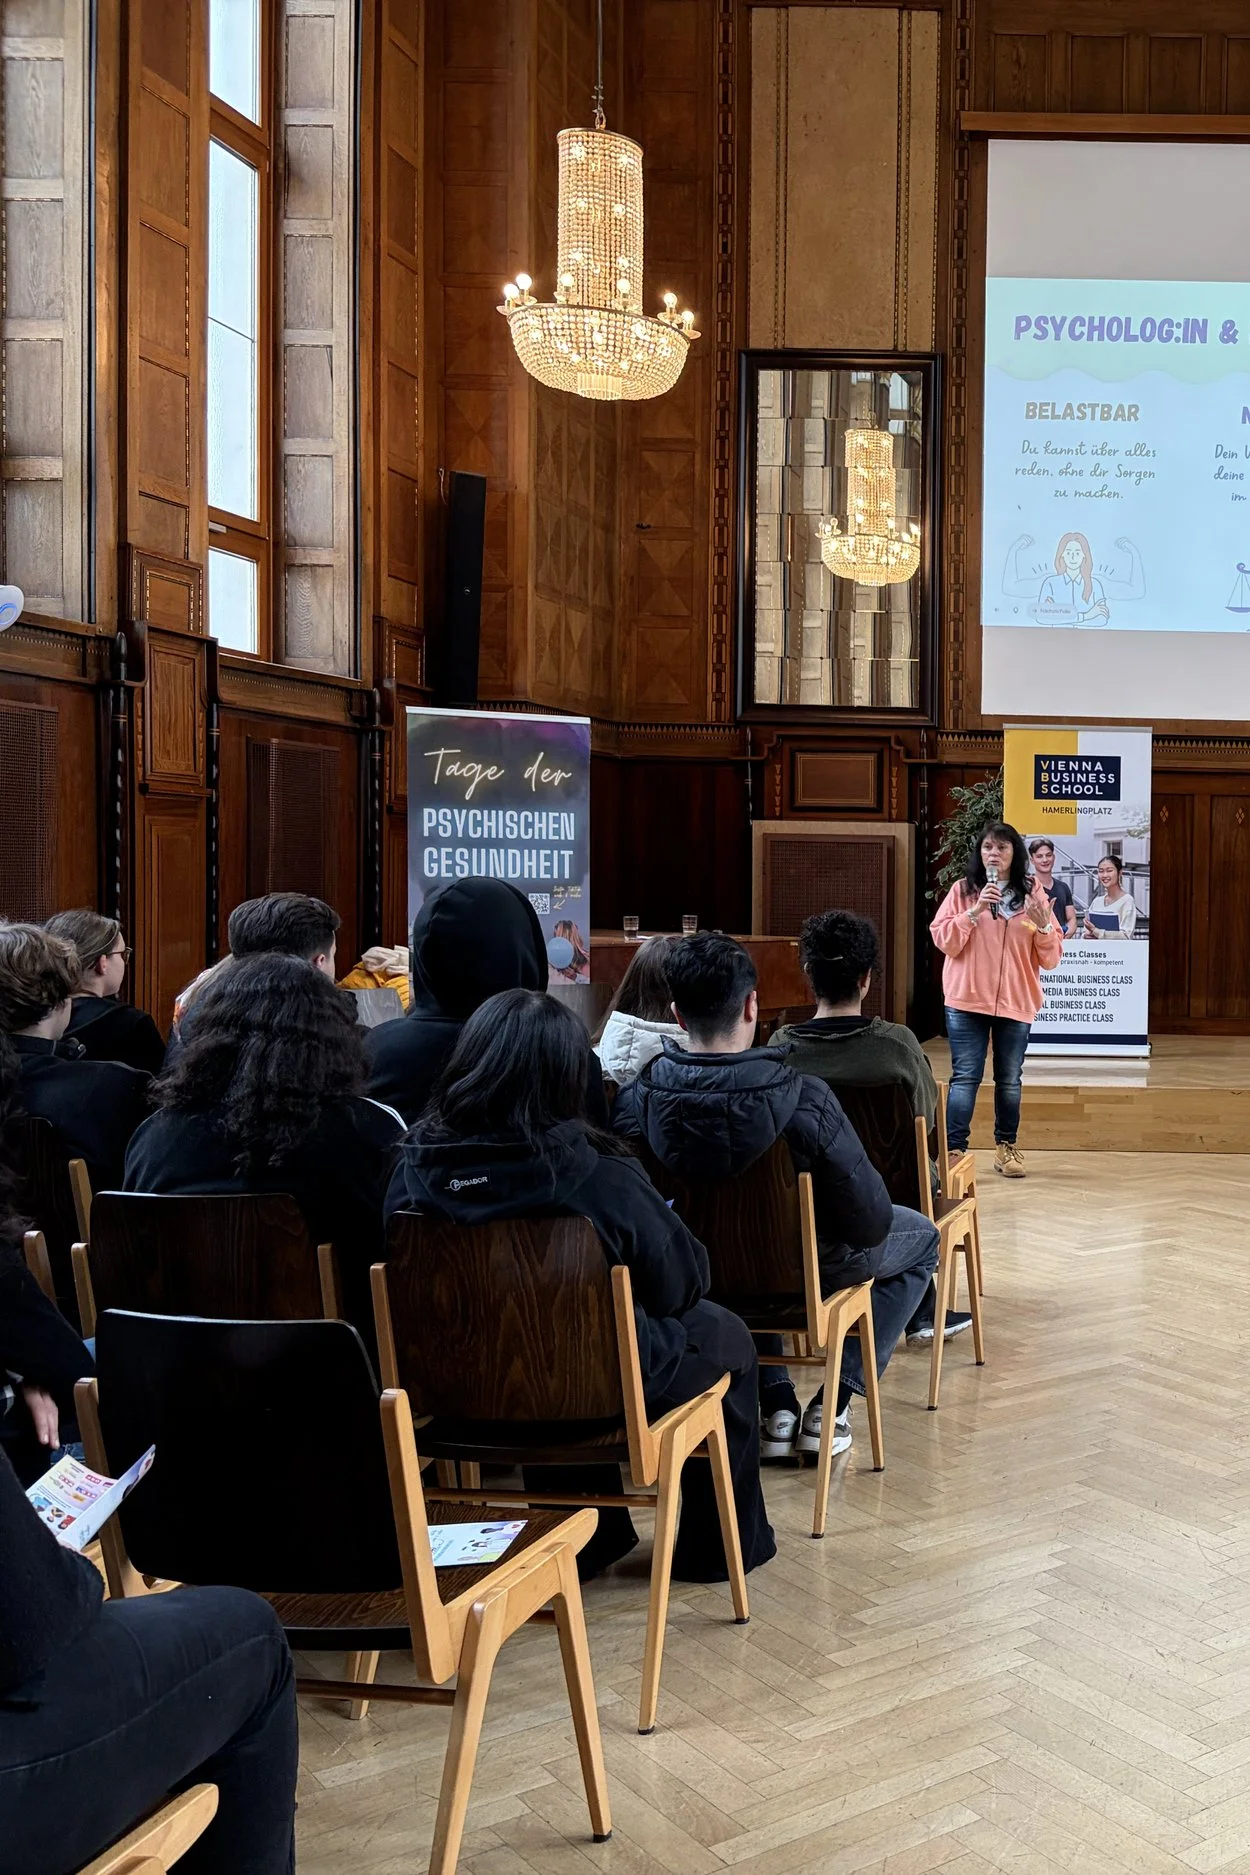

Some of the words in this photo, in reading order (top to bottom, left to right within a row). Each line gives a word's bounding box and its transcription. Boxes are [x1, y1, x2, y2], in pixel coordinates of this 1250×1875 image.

[1014, 315, 1208, 344] PSYCHOLOG:IN
[1219, 319, 1239, 345] &
[1025, 402, 1140, 421] BELASTBAR
[1021, 440, 1038, 454] Du
[1043, 441, 1087, 456] kannst
[1091, 442, 1119, 457] über
[1125, 443, 1157, 457] alles
[1214, 444, 1238, 459] Dein
[1058, 462, 1084, 477] ohne
[1090, 463, 1109, 477] dir
[1115, 464, 1155, 486] Sorgen
[1213, 465, 1244, 480] deine
[1054, 489, 1068, 498] zu
[1074, 484, 1124, 499] machen.
[1231, 492, 1247, 501] im
[1041, 760, 1103, 771] VIENNA
[424, 747, 504, 800] Tage
[524, 752, 572, 792] der
[1041, 772, 1115, 783] BUSINESS
[1041, 784, 1103, 795] SCHOOL
[1042, 806, 1112, 815] HAMERLINGPLATZ
[423, 808, 575, 841] PSYCHISCHEN
[423, 847, 574, 879] GESUNDHEIT
[1079, 950, 1107, 958] Classes
[1040, 975, 1075, 984] RNATIONAL
[1077, 975, 1110, 984] BUSINESS
[1111, 976, 1133, 984] CLASS
[1064, 987, 1097, 996] BUSINESS
[1099, 988, 1120, 997] CLASS
[1050, 1000, 1083, 1009] BUSINESS
[1084, 1001, 1106, 1009] CLASS
[1034, 1013, 1058, 1022] SINESS
[1059, 1013, 1090, 1022] PRACTICE
[1092, 1013, 1114, 1022] CLASS
